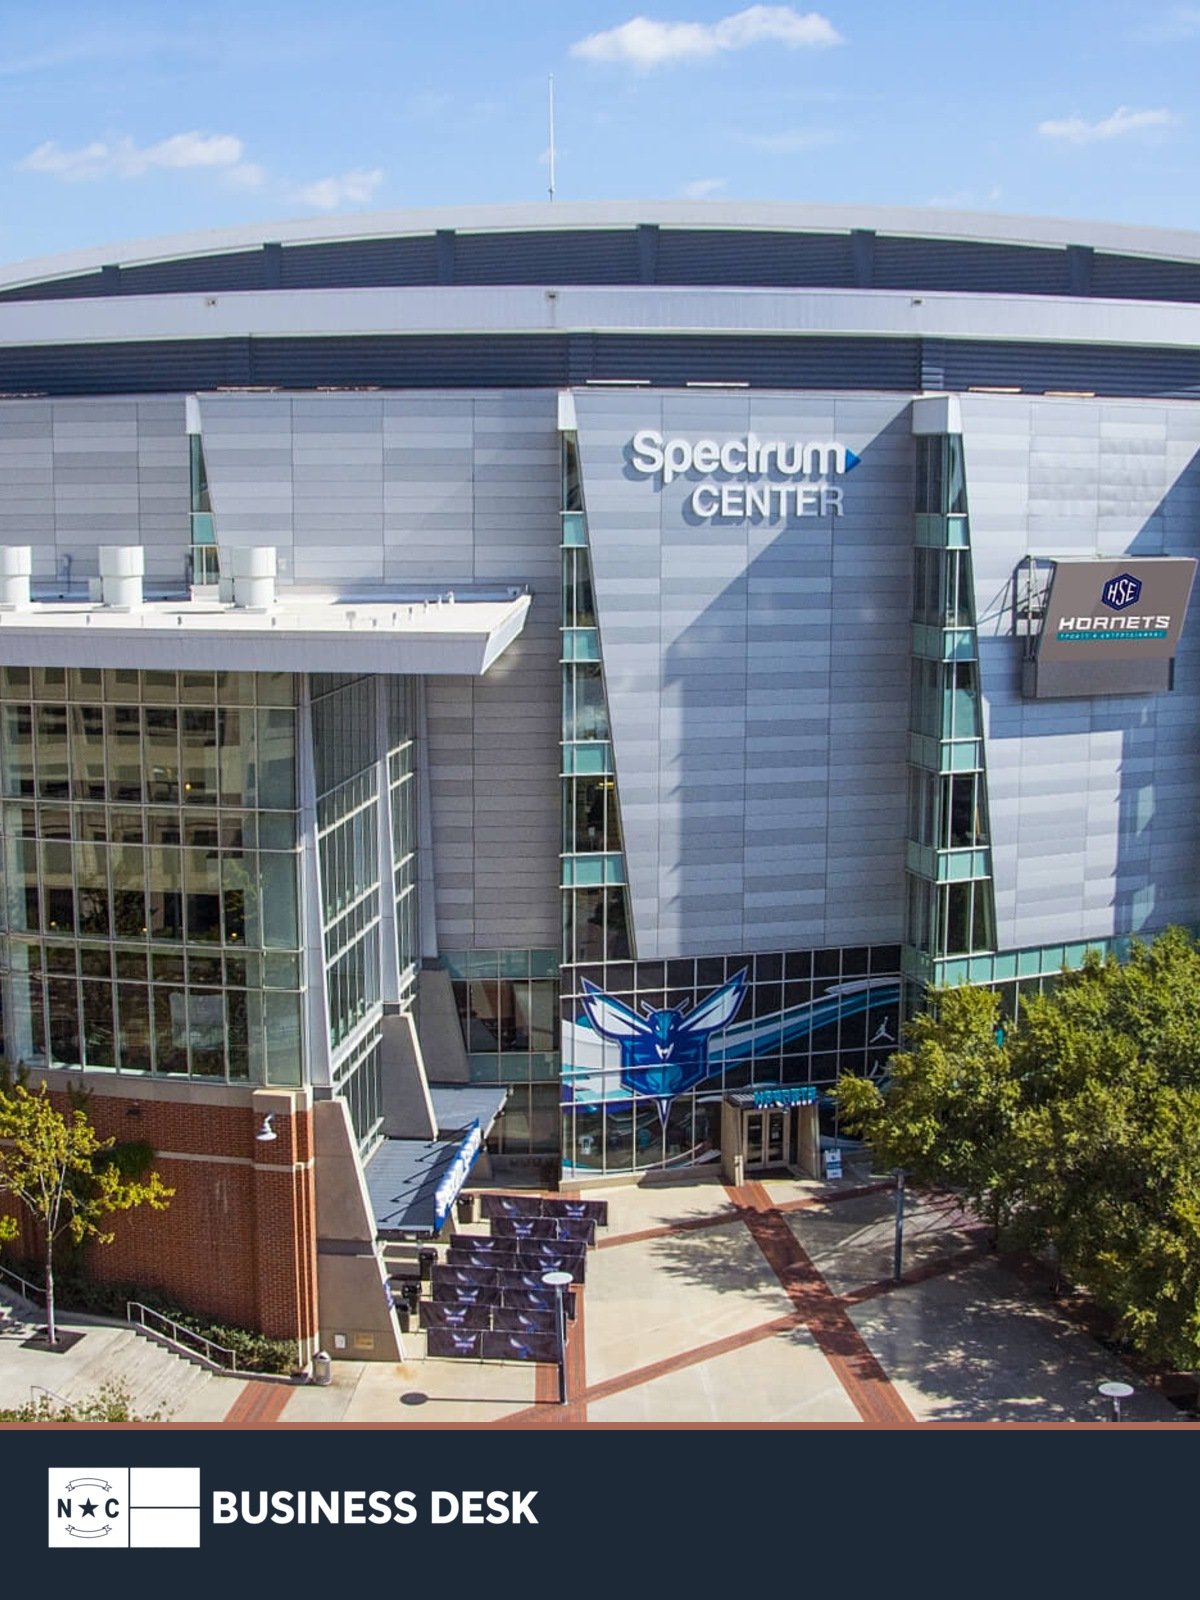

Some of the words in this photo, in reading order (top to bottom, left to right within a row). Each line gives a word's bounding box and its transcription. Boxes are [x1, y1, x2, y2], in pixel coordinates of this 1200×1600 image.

[633, 430, 845, 483] Spectrum
[692, 484, 844, 517] CENTER
[1107, 579, 1137, 606] HSE
[1058, 615, 1171, 631] HORNETS
